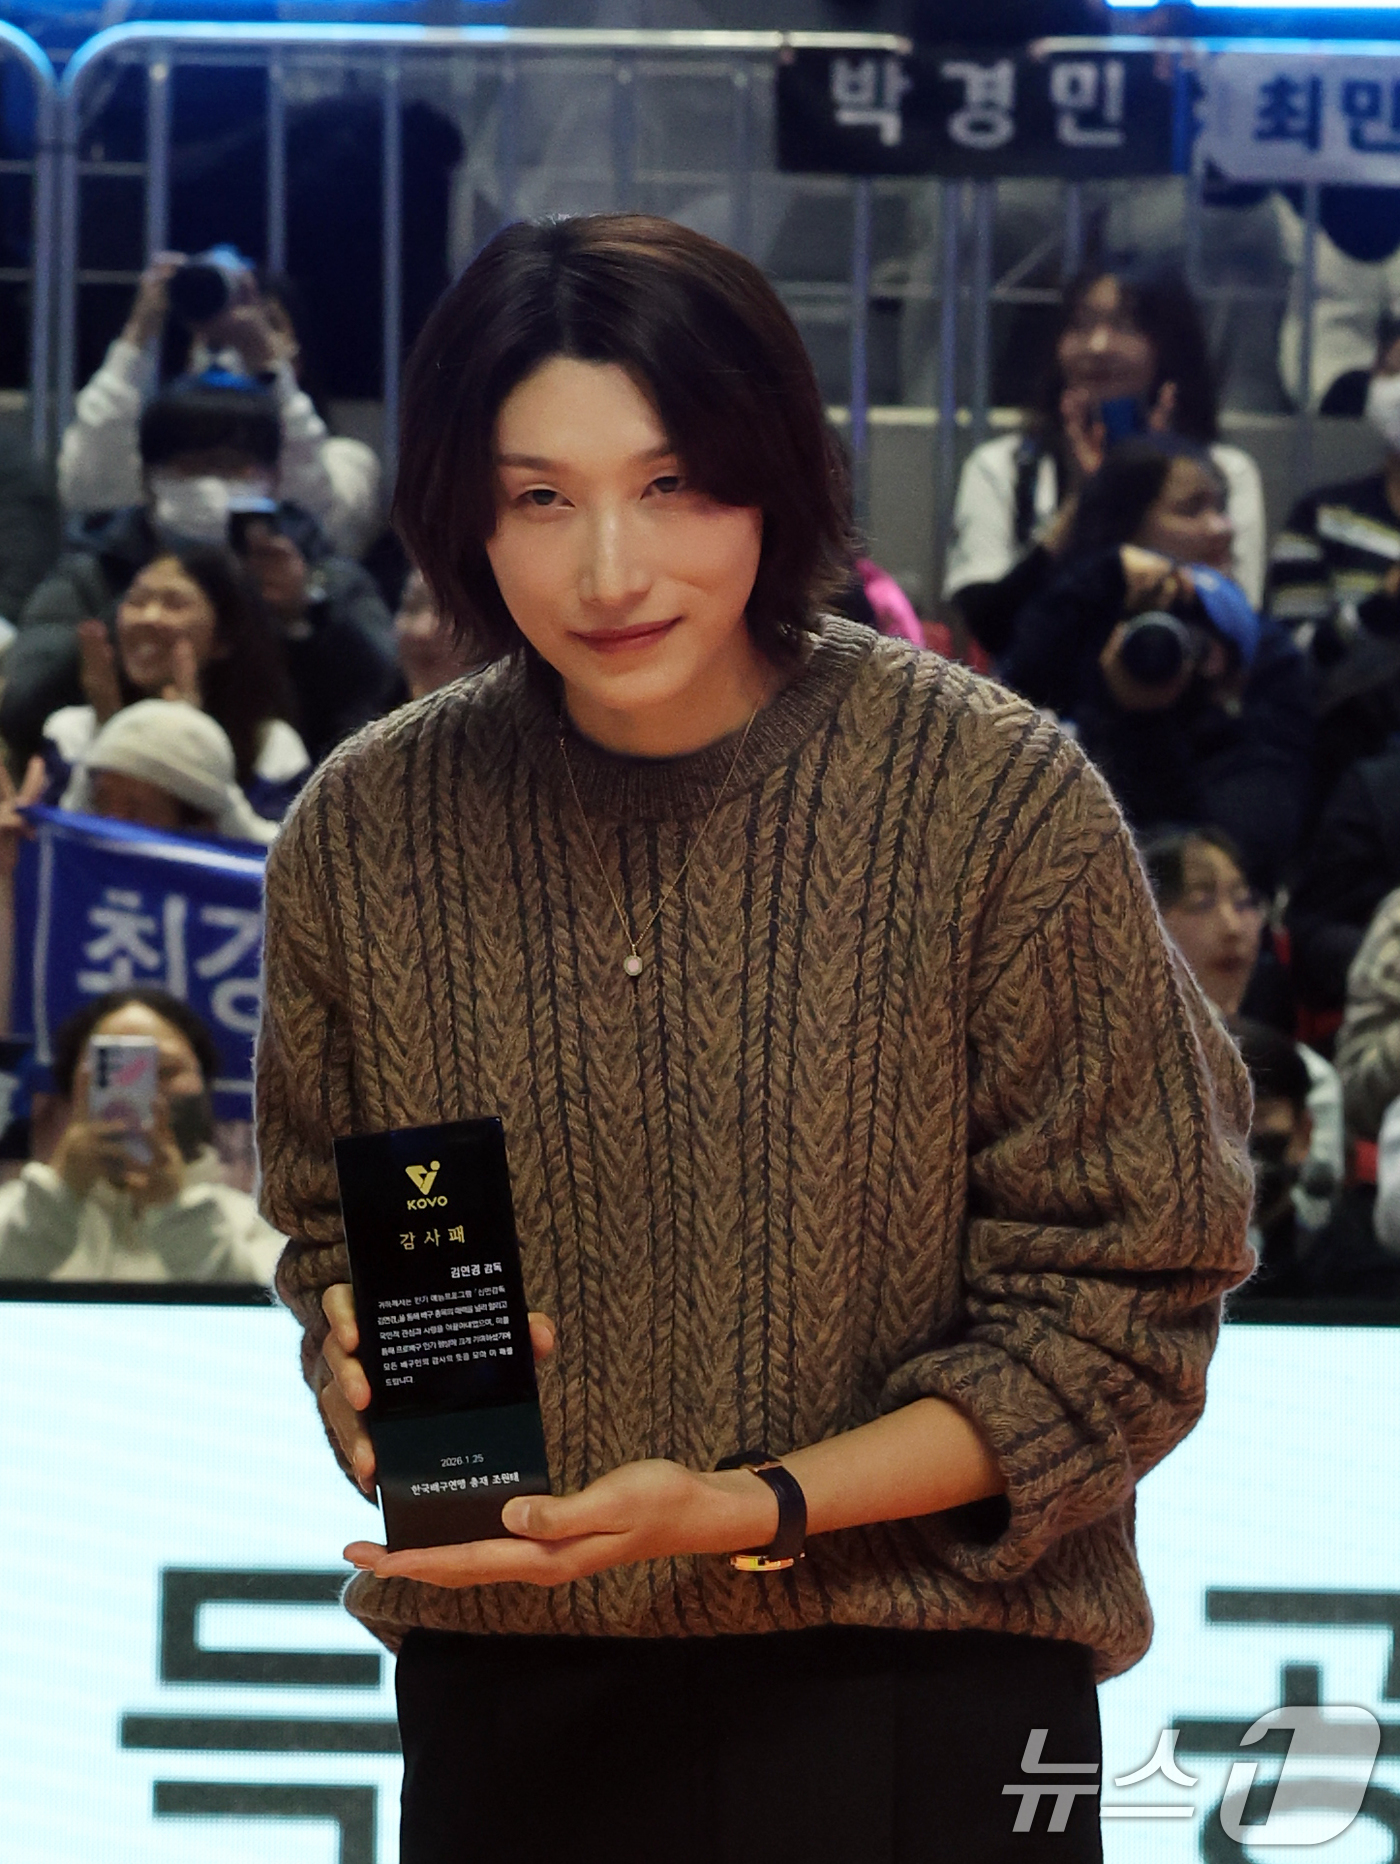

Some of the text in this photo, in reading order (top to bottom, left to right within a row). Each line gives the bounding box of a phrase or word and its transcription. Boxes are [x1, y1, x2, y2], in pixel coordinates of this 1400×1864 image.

[407, 1196, 448, 1210] KOVO
[451, 1262, 502, 1278] 김연경 감독
[430, 1290, 472, 1302] 예능프로그램
[420, 1311, 434, 1319] 배구
[380, 1331, 400, 1340] 국민적
[402, 1328, 421, 1338] 관심과
[423, 1325, 443, 1334] 사랑을
[384, 1362, 397, 1370] 모든
[432, 1355, 453, 1365] 감사의
[410, 1472, 520, 1495] 한국배구연맹 총재 조원태
